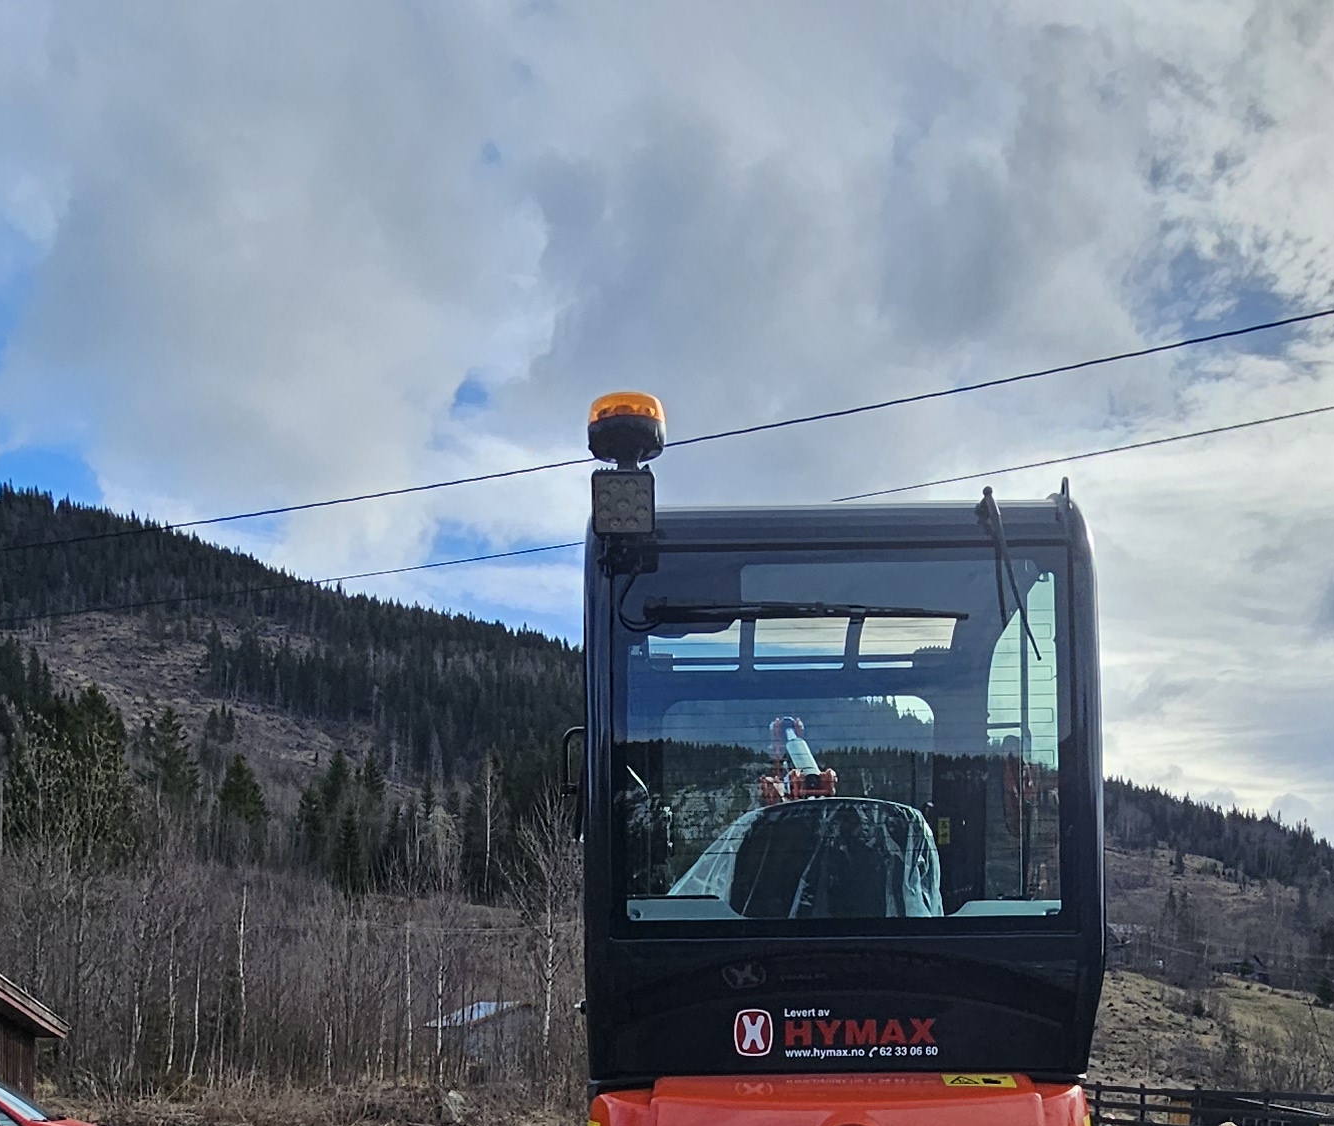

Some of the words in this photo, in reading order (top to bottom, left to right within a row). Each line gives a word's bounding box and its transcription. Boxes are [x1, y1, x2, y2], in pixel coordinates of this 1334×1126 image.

[784, 1008, 815, 1018] Levert
[817, 1009, 830, 1017] av
[784, 1018, 936, 1046] HYMAX
[785, 1048, 865, 1059] www.hymax.no
[879, 1046, 892, 1056] 62
[894, 1046, 907, 1056] 33
[909, 1046, 922, 1056] 06
[925, 1046, 938, 1056] 60
